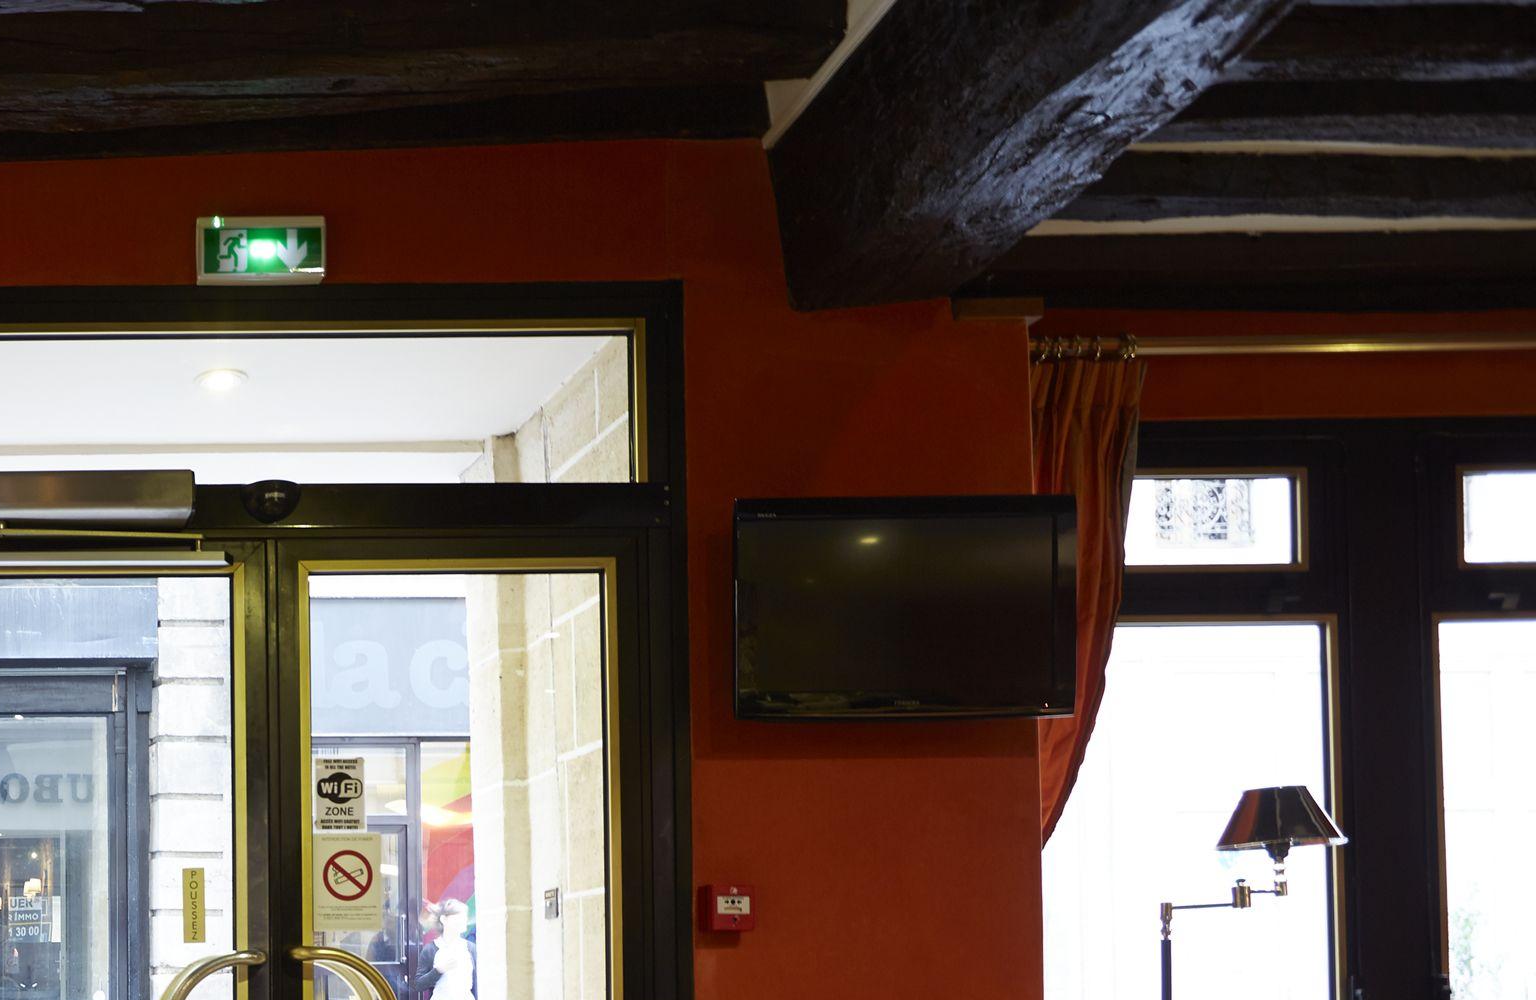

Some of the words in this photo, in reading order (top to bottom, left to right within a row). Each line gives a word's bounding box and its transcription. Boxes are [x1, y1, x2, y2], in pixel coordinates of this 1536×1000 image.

[311, 620, 468, 709] lac
[325, 807, 354, 816] ZONE
[189, 871, 199, 940] POUSSEZ
[15, 927, 26, 936] 30
[28, 926, 39, 936] 00
